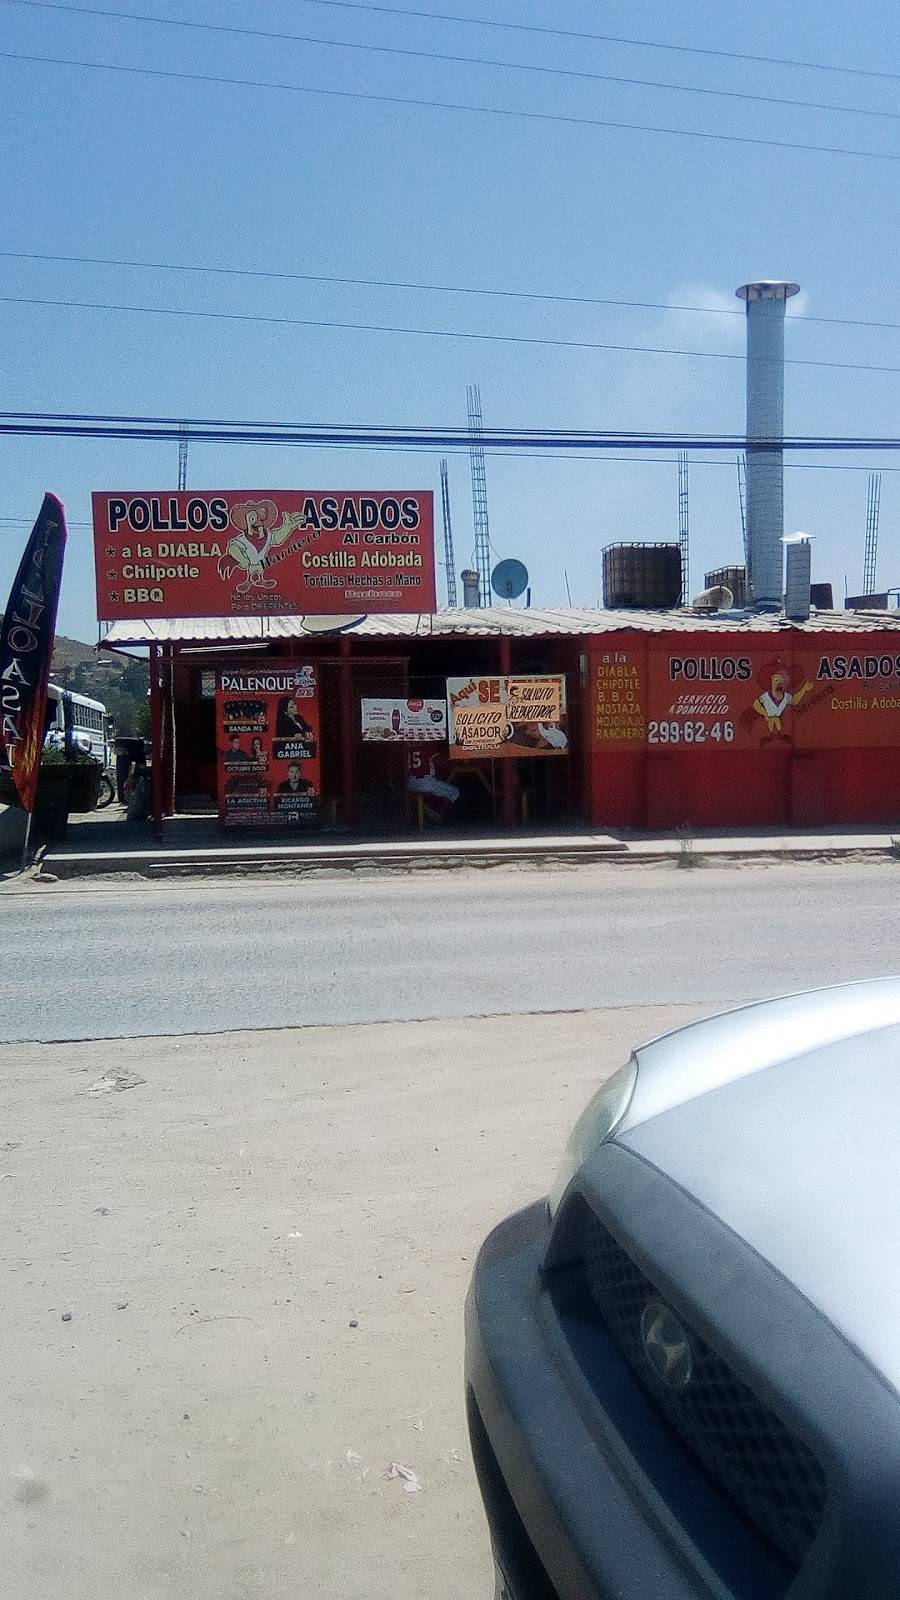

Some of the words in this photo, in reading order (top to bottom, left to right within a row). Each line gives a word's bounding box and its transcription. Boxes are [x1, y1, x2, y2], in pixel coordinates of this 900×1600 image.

[108, 498, 229, 532] POLLOS
[300, 498, 420, 531] ASADOS
[344, 533, 358, 544] Al
[363, 531, 419, 544] Carbón
[121, 547, 131, 558] a
[137, 543, 152, 558] la
[158, 543, 222, 558] DIABLA
[302, 551, 356, 568] Costilla
[360, 551, 422, 568] Adobada
[122, 564, 199, 582] Chilpotle
[303, 574, 344, 587] Tortillas
[348, 574, 384, 586] Hechas
[386, 577, 392, 586] a
[395, 573, 421, 586] Mano
[124, 588, 164, 603] BBQ
[602, 655, 610, 663] a
[614, 652, 627, 662] la
[598, 666, 638, 677] DIABLA
[669, 656, 752, 682] POLLOS
[221, 676, 294, 691] PALENQUE
[596, 679, 640, 690] CHIPOTLE
[478, 680, 500, 704] SE
[519, 687, 555, 701] SOLICITO
[676, 695, 727, 705] SERVICIO
[831, 697, 868, 710] Costilla
[596, 703, 640, 715] MOSTAZA
[675, 704, 729, 715] DOMICILIO
[456, 711, 502, 726] SOLICITO
[460, 727, 501, 740] ASADOR
[277, 750, 311, 758] GABRIEL
